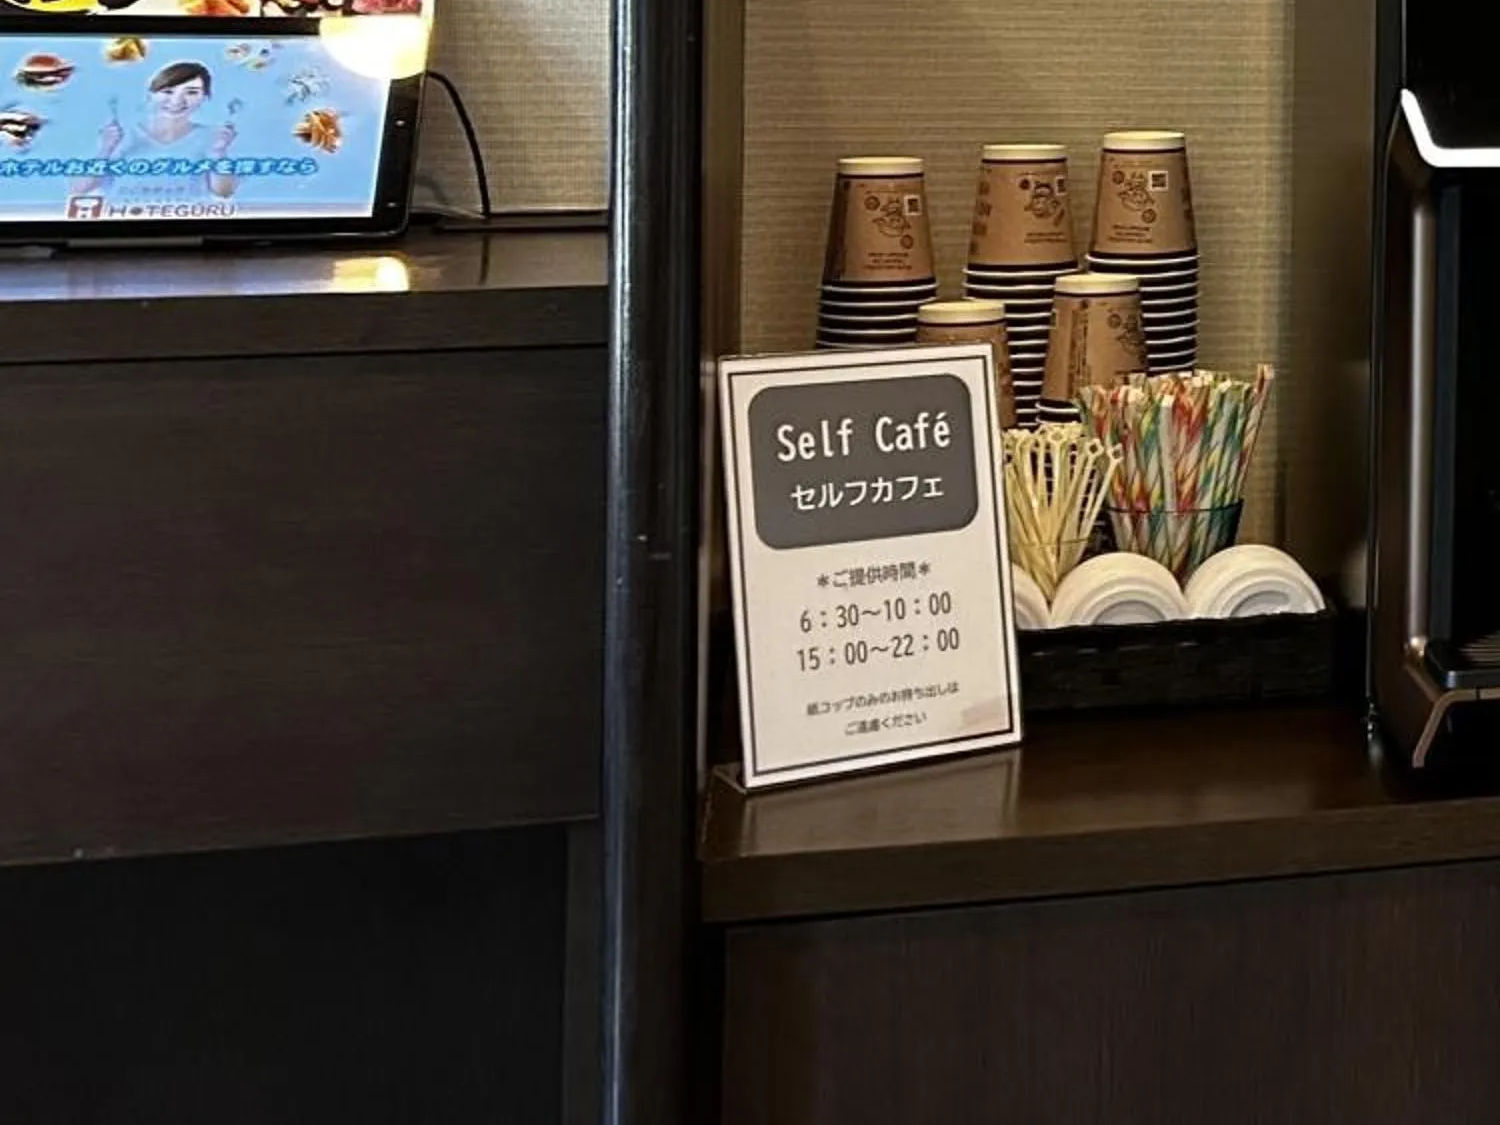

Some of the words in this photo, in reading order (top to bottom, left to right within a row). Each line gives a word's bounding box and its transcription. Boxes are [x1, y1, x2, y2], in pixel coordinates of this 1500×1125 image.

[776, 418, 853, 462] Self
[875, 412, 951, 452] Café
[791, 476, 944, 510] セルフカフェ
